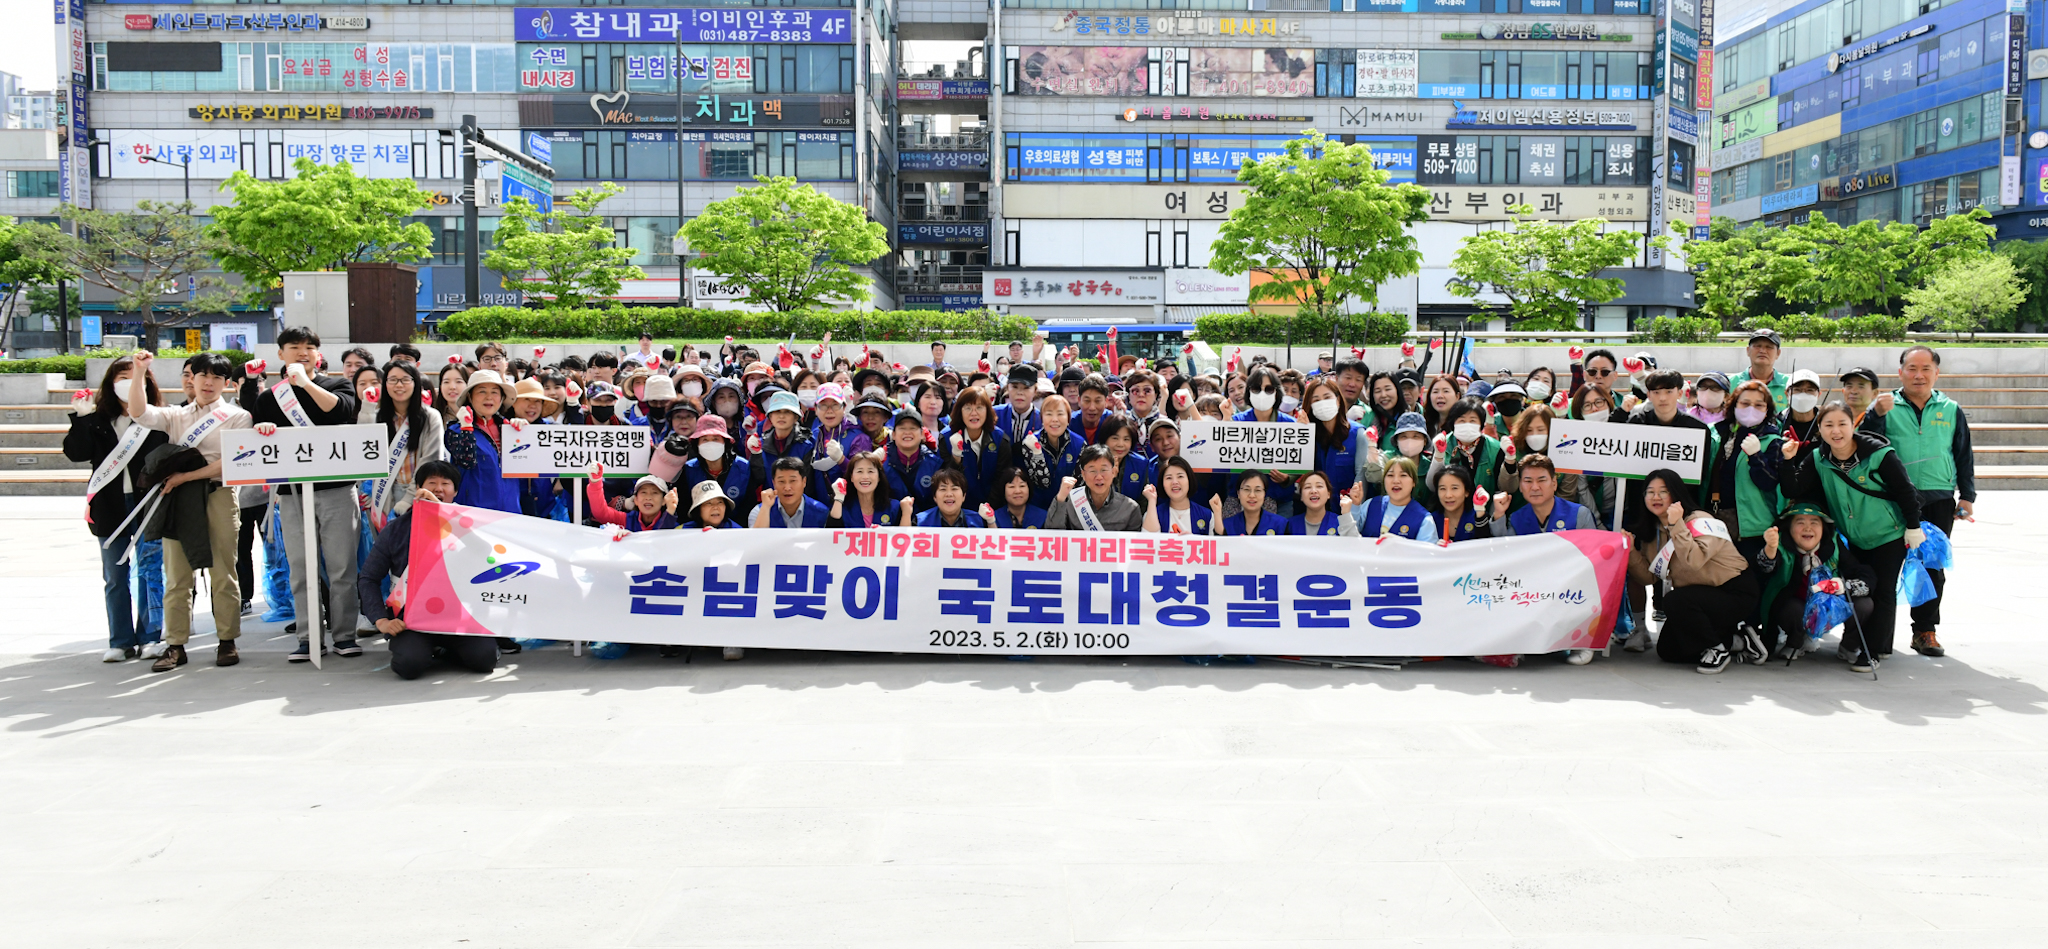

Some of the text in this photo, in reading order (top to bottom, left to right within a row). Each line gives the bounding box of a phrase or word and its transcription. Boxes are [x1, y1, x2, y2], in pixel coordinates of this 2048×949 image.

[155, 12, 247, 31] 세인트파크
[250, 12, 321, 31] 산부인과
[570, 12, 682, 38] 참내과
[700, 10, 812, 29] 이비인후과
[821, 18, 846, 35] 4F
[1075, 16, 1300, 36] 중국정통 아로마 마사지 4F
[699, 29, 812, 41] (031) 487-8383
[73, 28, 84, 73] 산부인과
[354, 46, 389, 64] 여성
[531, 48, 566, 65] 수면
[1389, 52, 1416, 64] 마사지
[1656, 33, 1665, 79] 한의원
[283, 59, 332, 76] 요실금
[2012, 39, 2020, 82] 디와이짐
[342, 69, 407, 88] 성형수술
[522, 70, 576, 88] 내시경
[1391, 67, 1415, 79] 마사지
[1673, 63, 1685, 81] 피부
[1864, 60, 1912, 91] 피부과
[1358, 83, 1416, 95] 스포츠 마사지
[1431, 87, 1466, 97] 피부질환
[1530, 87, 1557, 97] 여드름
[1611, 87, 1633, 97] 비만
[1672, 83, 1685, 102] 비만
[75, 86, 86, 126] 참내과
[262, 104, 342, 121] 외과의원
[348, 106, 420, 119] 486-9975
[696, 94, 782, 126] 치과 맥
[1142, 105, 1210, 120] 비올의원
[604, 110, 633, 123] MAC
[1371, 112, 1423, 122] MAMUI
[1479, 108, 1632, 126] 제이엠신용정보 509-7400
[632, 132, 662, 140] 치아교정
[799, 133, 837, 141] 레이저치료
[1723, 122, 1735, 140] 5F
[330, 144, 367, 163] 항문
[373, 144, 409, 163] 치질
[1025, 149, 1122, 166] 우호의료생협 성형
[1125, 149, 1144, 157] 피부
[1192, 151, 1220, 166] 보톡스
[1427, 142, 1477, 158] 무료 상담
[1530, 143, 1556, 158] 채권
[1608, 143, 1635, 158] 신용
[1125, 158, 1144, 166] 비만
[1423, 159, 1477, 175] 509-7400
[1529, 162, 1555, 177] 추심
[1607, 162, 1634, 177] 조사
[1867, 172, 1890, 188] Live
[1598, 193, 1635, 201] 피부과
[1697, 177, 1709, 203] 테라피
[1164, 191, 1229, 214] 여성
[1431, 192, 1563, 215] 산부인과
[1653, 186, 1661, 216] 안경
[1668, 194, 1695, 216] 산부인과
[1935, 200, 1963, 215] LEAHA
[1598, 207, 1634, 216] 성형외과
[1067, 280, 1113, 296] 칼국수
[537, 430, 645, 449] 한국자유총연맹
[1212, 426, 1310, 446] 바르게살기운동
[261, 438, 380, 465] 안산시청
[1219, 447, 1302, 465] 안산시협의회
[1582, 436, 1698, 463] 안산시 새마을회
[553, 450, 630, 468] 안산시지회
[832, 531, 1230, 567] 「제19회 안산국제거리극축제」
[1453, 573, 1492, 595] 시민과
[481, 590, 528, 605] 안산시
[629, 564, 1423, 629] 손님맞이 국토대청결운동
[1467, 589, 1587, 611] 자유로운 혁신도시 안산
[929, 630, 987, 648] 2023.
[993, 632, 1012, 648] 5.
[1074, 632, 1130, 649] 10:00
